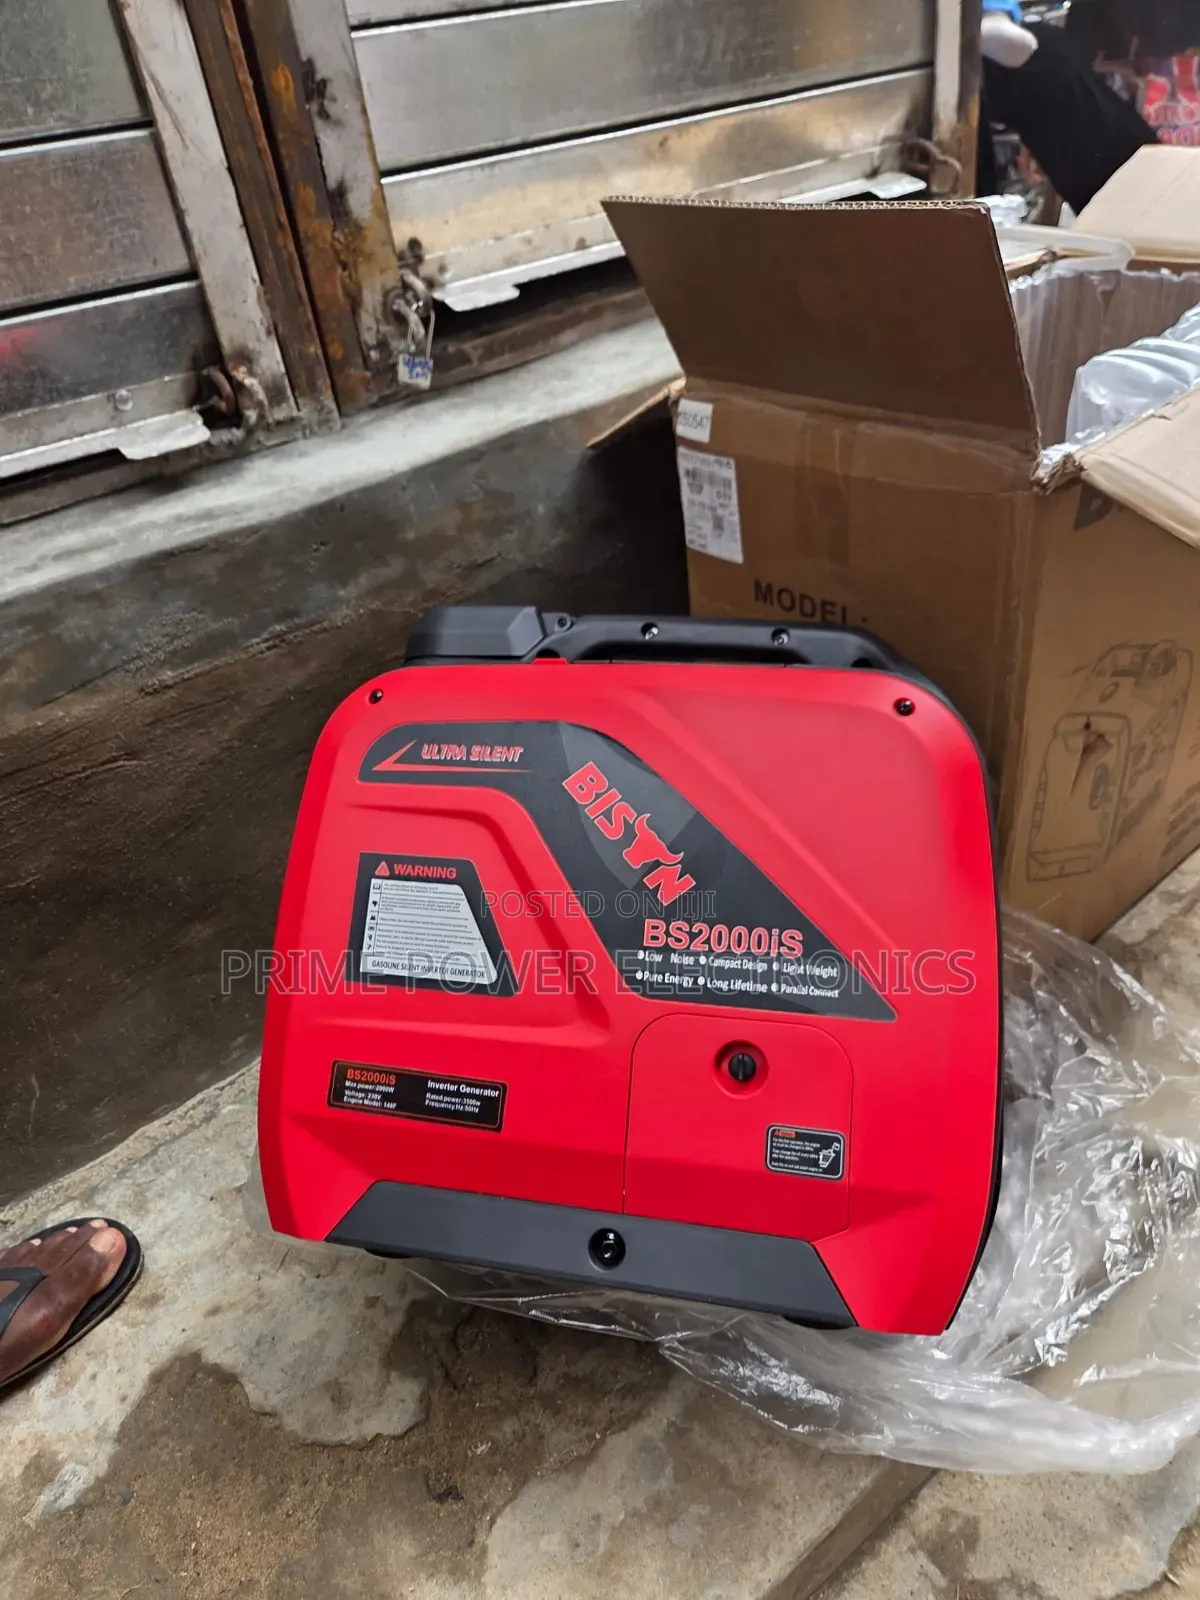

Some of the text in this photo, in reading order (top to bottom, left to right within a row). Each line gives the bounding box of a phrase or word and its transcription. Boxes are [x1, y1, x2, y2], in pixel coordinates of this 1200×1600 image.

[421, 744, 523, 763] ULTRA SILENT
[394, 863, 457, 879] WARNING
[643, 918, 804, 959] BS2000iS
[645, 951, 695, 966] Low Noise
[708, 956, 768, 973] Compact Design
[371, 959, 401, 970] GASOLINE
[450, 966, 486, 978] GENERATOR
[782, 961, 838, 980] Light Weight
[643, 971, 694, 987] Pure Energy
[706, 976, 768, 993] Long Lifetime
[346, 1069, 396, 1085] BS2000iS
[427, 1079, 499, 1098] Inverter Generator
